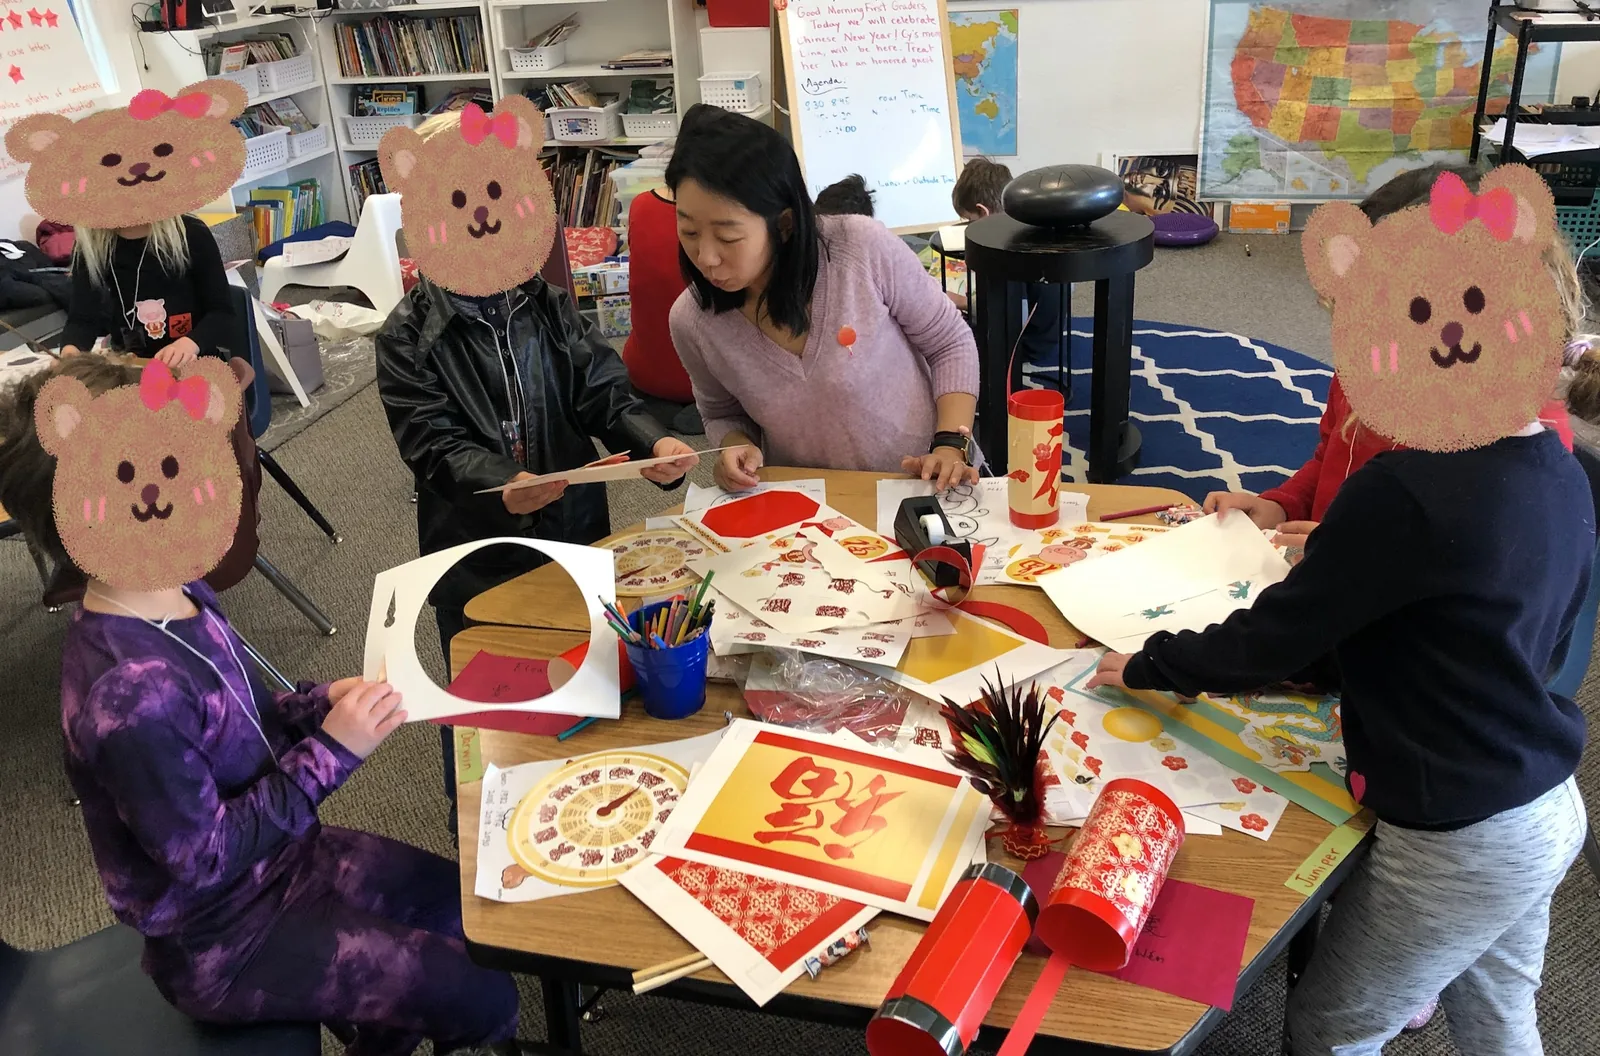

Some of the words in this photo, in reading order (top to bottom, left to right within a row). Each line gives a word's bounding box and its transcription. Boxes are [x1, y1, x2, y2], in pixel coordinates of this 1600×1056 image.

[797, 6, 821, 18] Good
[828, 6, 865, 21] Morning
[865, 3, 887, 12] First
[811, 20, 840, 33] Today
[868, 16, 886, 25] will
[891, 15, 936, 25] celebrate
[797, 36, 837, 45] Chinese
[844, 32, 866, 42] New
[902, 29, 919, 41] Cy's
[831, 46, 848, 54] will
[905, 42, 934, 53] Treat
[800, 62, 820, 71] her
[831, 60, 848, 68] like
[871, 57, 907, 66] honored
[1295, 846, 1340, 889] Juniper
